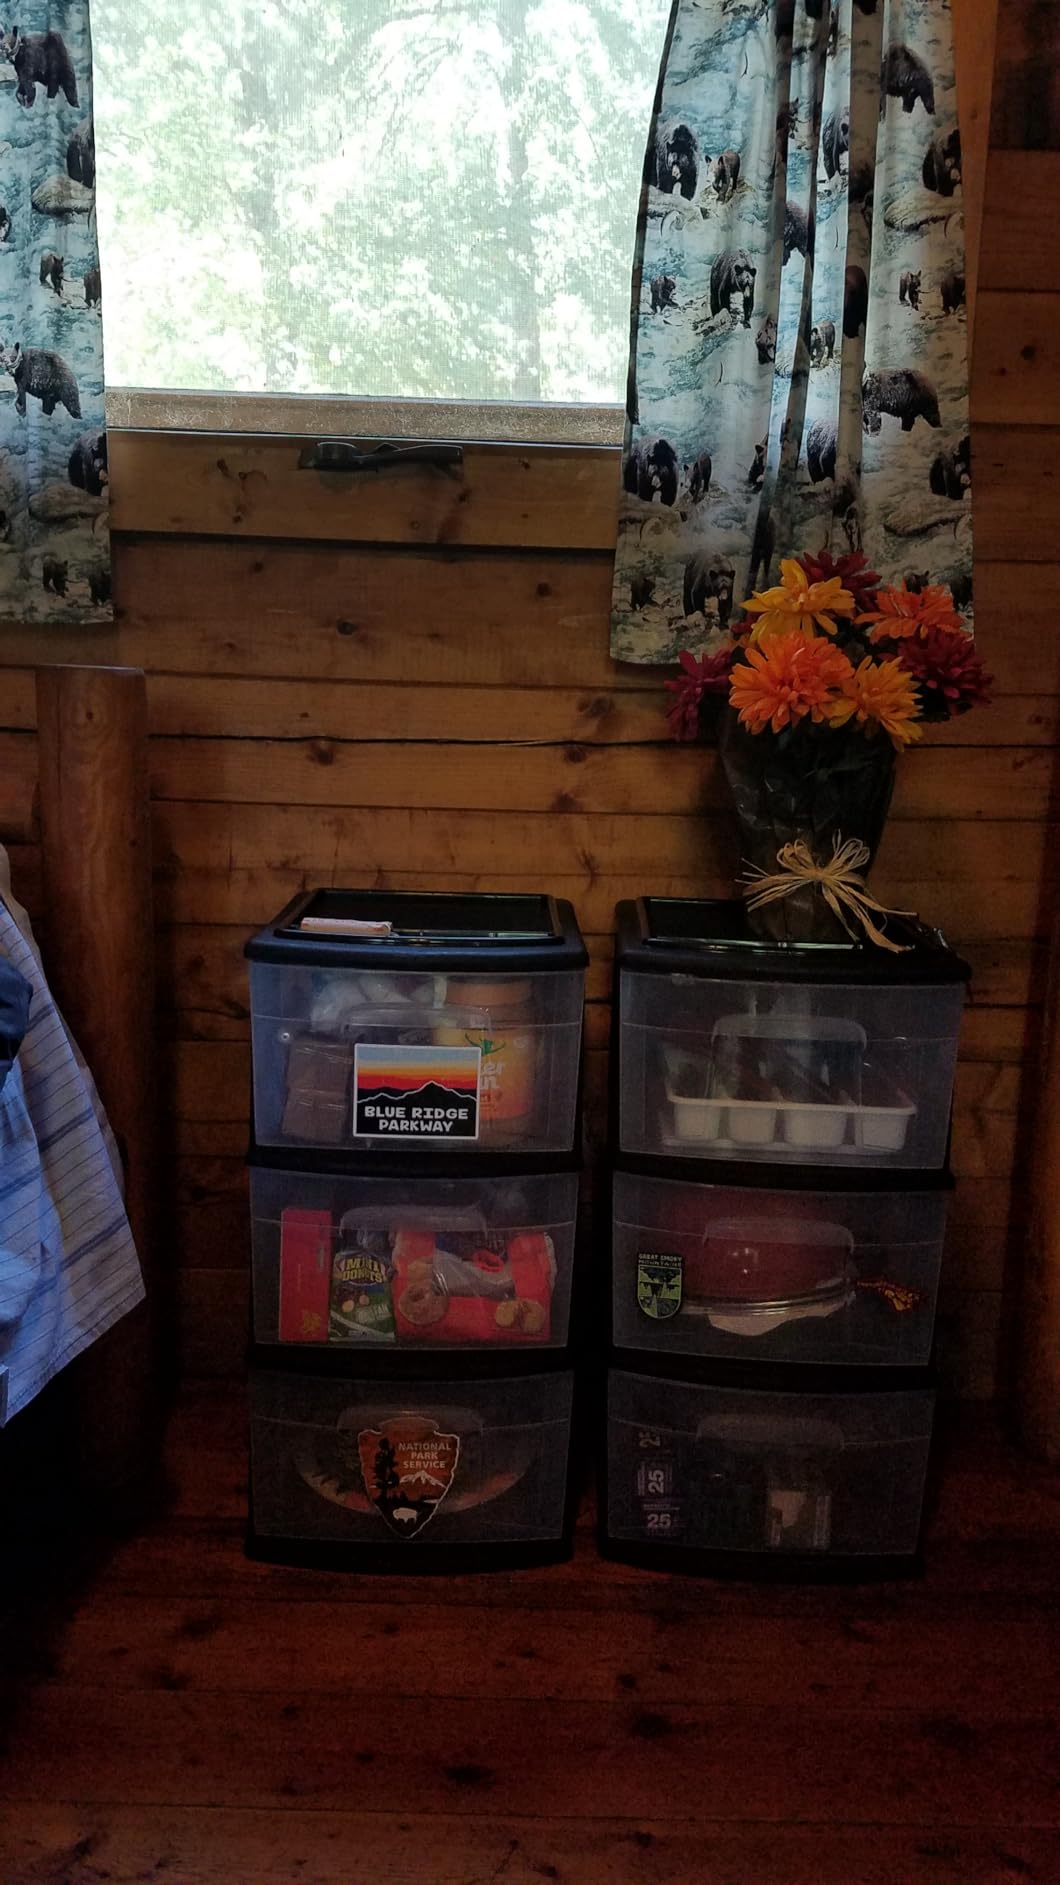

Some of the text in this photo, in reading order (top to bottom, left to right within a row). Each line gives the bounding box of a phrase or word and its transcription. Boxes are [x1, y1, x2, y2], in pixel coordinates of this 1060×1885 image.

[364, 1105, 469, 1120] BLUE RIDGE
[378, 1119, 454, 1133] PARKWAY
[345, 1255, 380, 1272] MINI
[342, 1268, 383, 1283] DONUTS
[398, 1442, 452, 1451] NATIONAL
[410, 1451, 439, 1460] PARK
[403, 1460, 446, 1470] SERVICE
[647, 1469, 664, 1494] 25
[647, 1512, 671, 1529] 25
